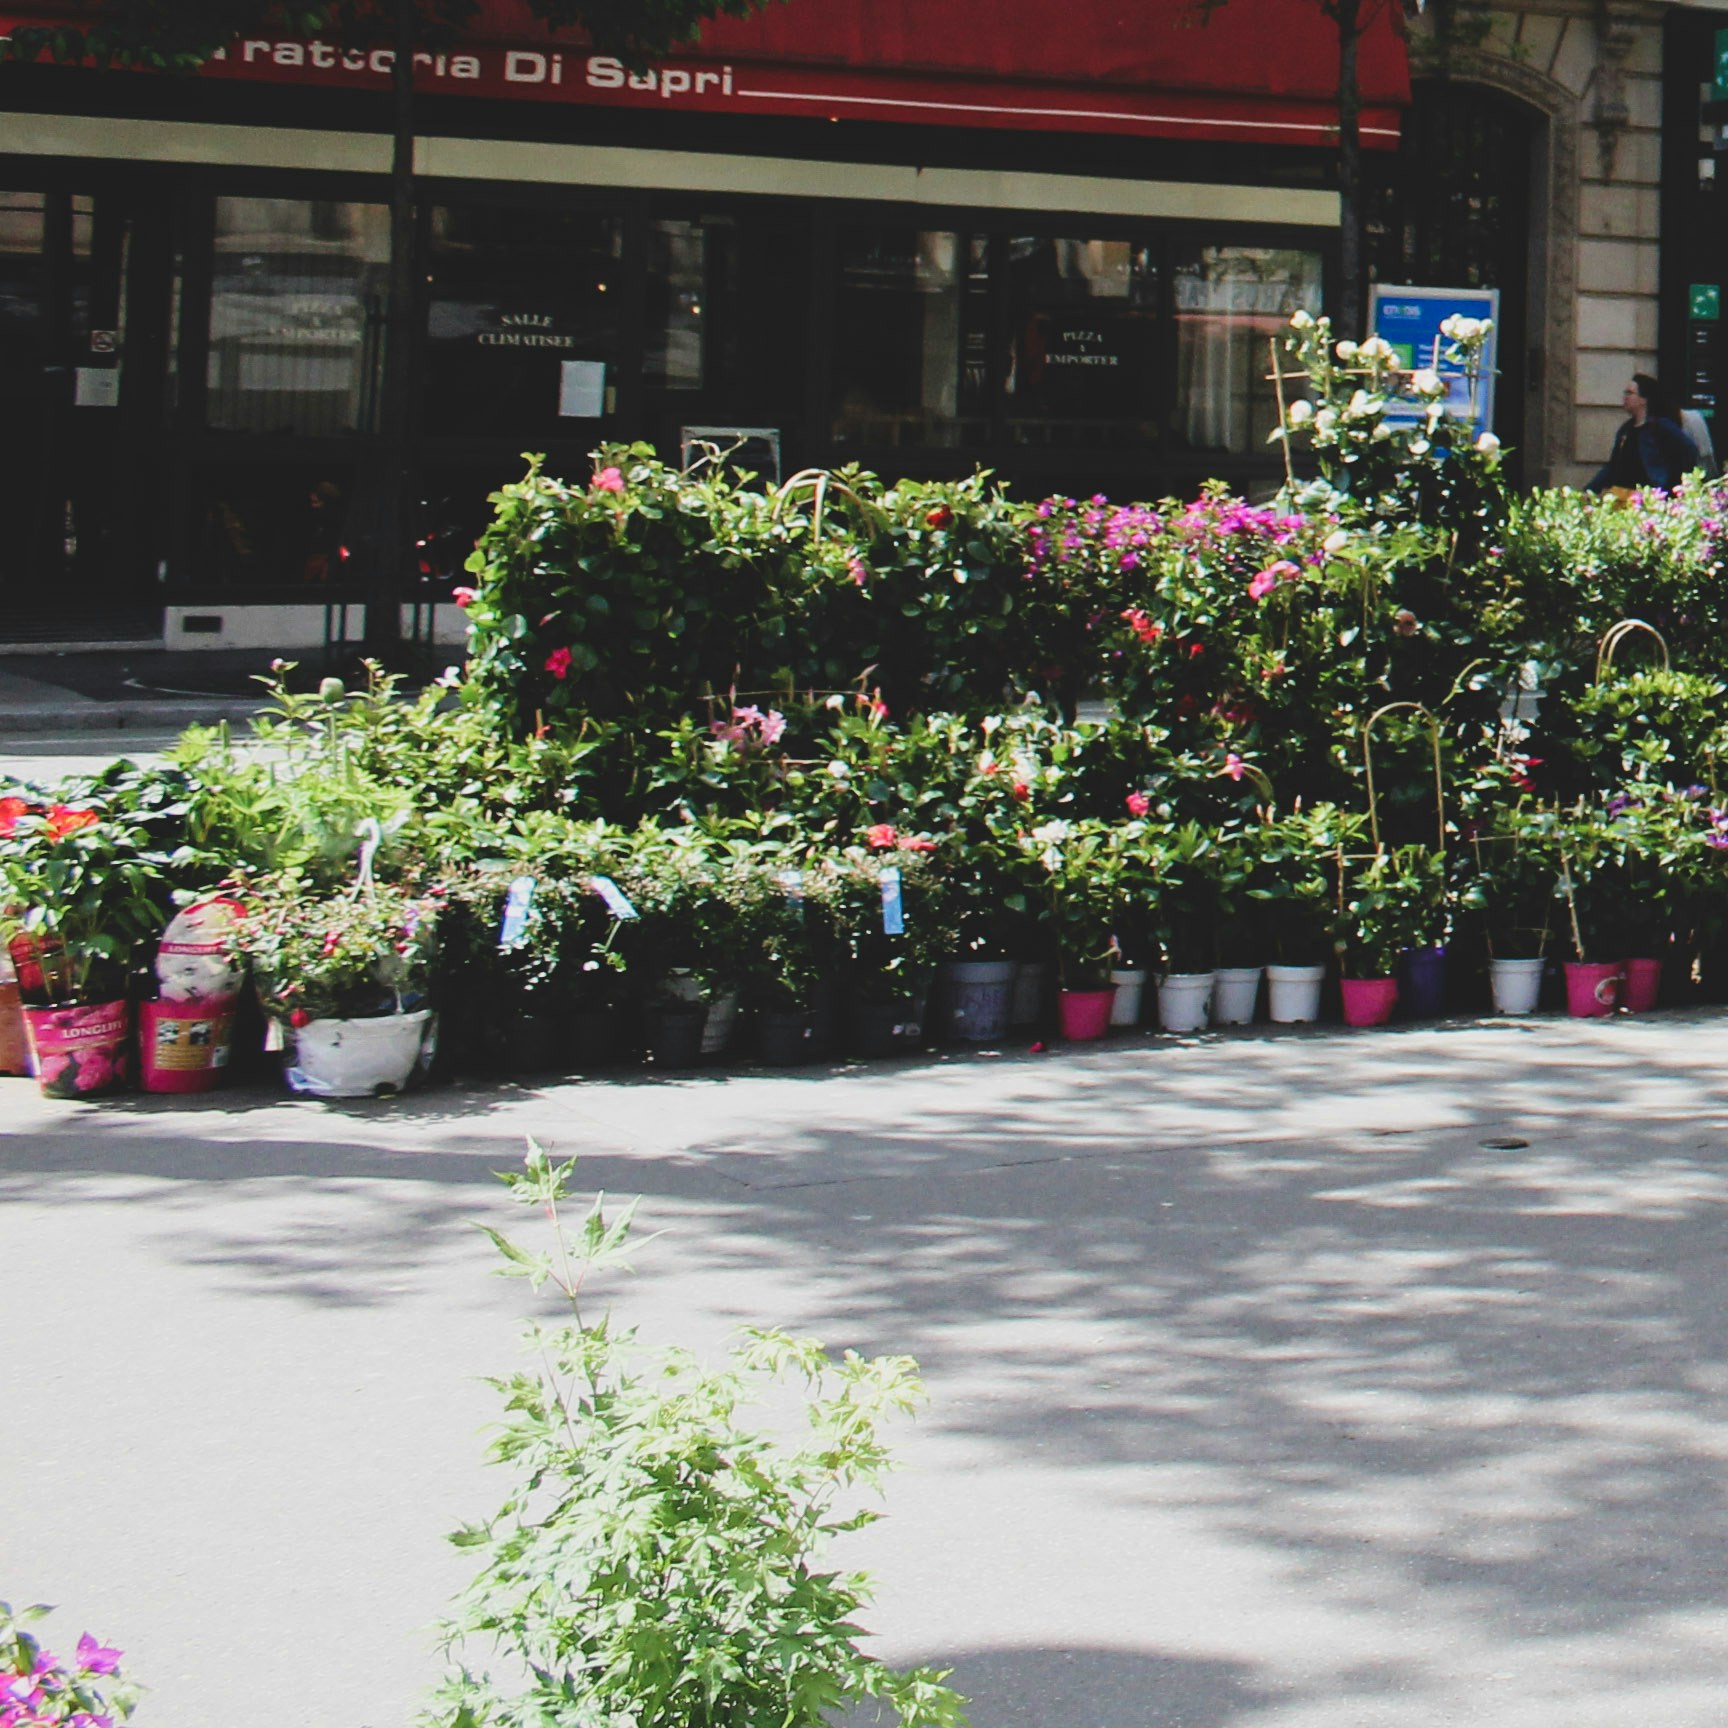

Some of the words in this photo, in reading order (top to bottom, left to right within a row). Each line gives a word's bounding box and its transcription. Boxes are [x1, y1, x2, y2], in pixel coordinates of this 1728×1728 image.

[211, 33, 480, 80] rattoria
[504, 50, 562, 85] Di
[586, 55, 733, 99] Sapri
[501, 313, 553, 328] SALLE
